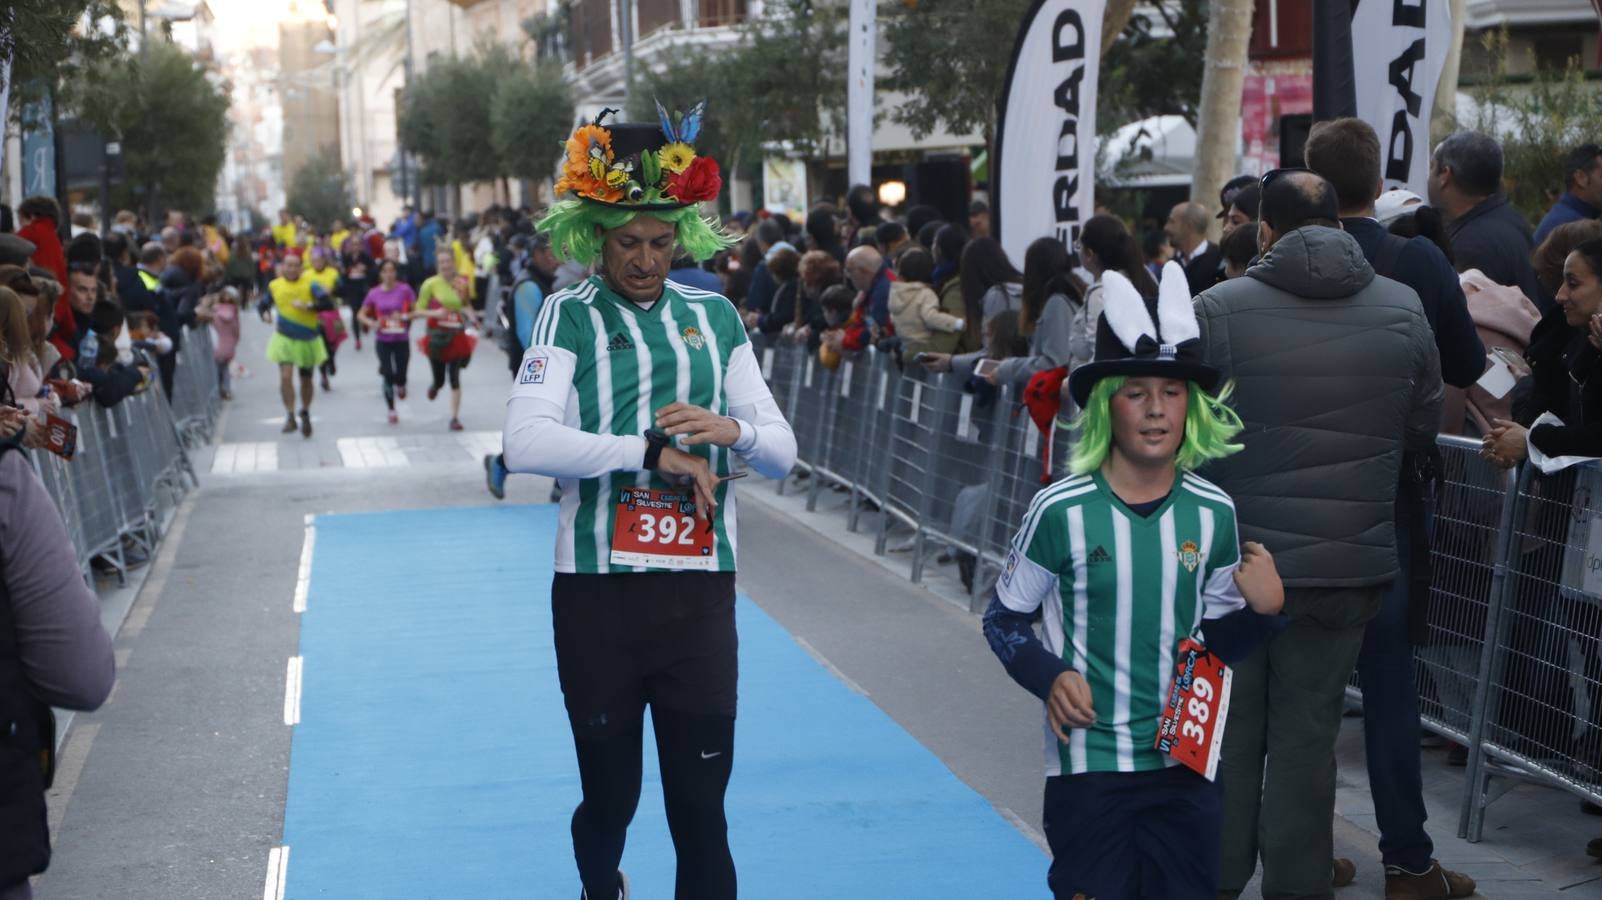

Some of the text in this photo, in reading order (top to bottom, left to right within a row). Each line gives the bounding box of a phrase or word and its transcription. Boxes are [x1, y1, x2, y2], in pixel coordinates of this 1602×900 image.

[524, 373, 541, 382] LFP
[634, 491, 650, 499] SAN
[636, 499, 672, 509] SILVESTRE
[638, 513, 695, 545] 392
[1170, 696, 1184, 736] SILVESTRE
[1183, 677, 1214, 745] 389
[1162, 718, 1171, 736] SAN
